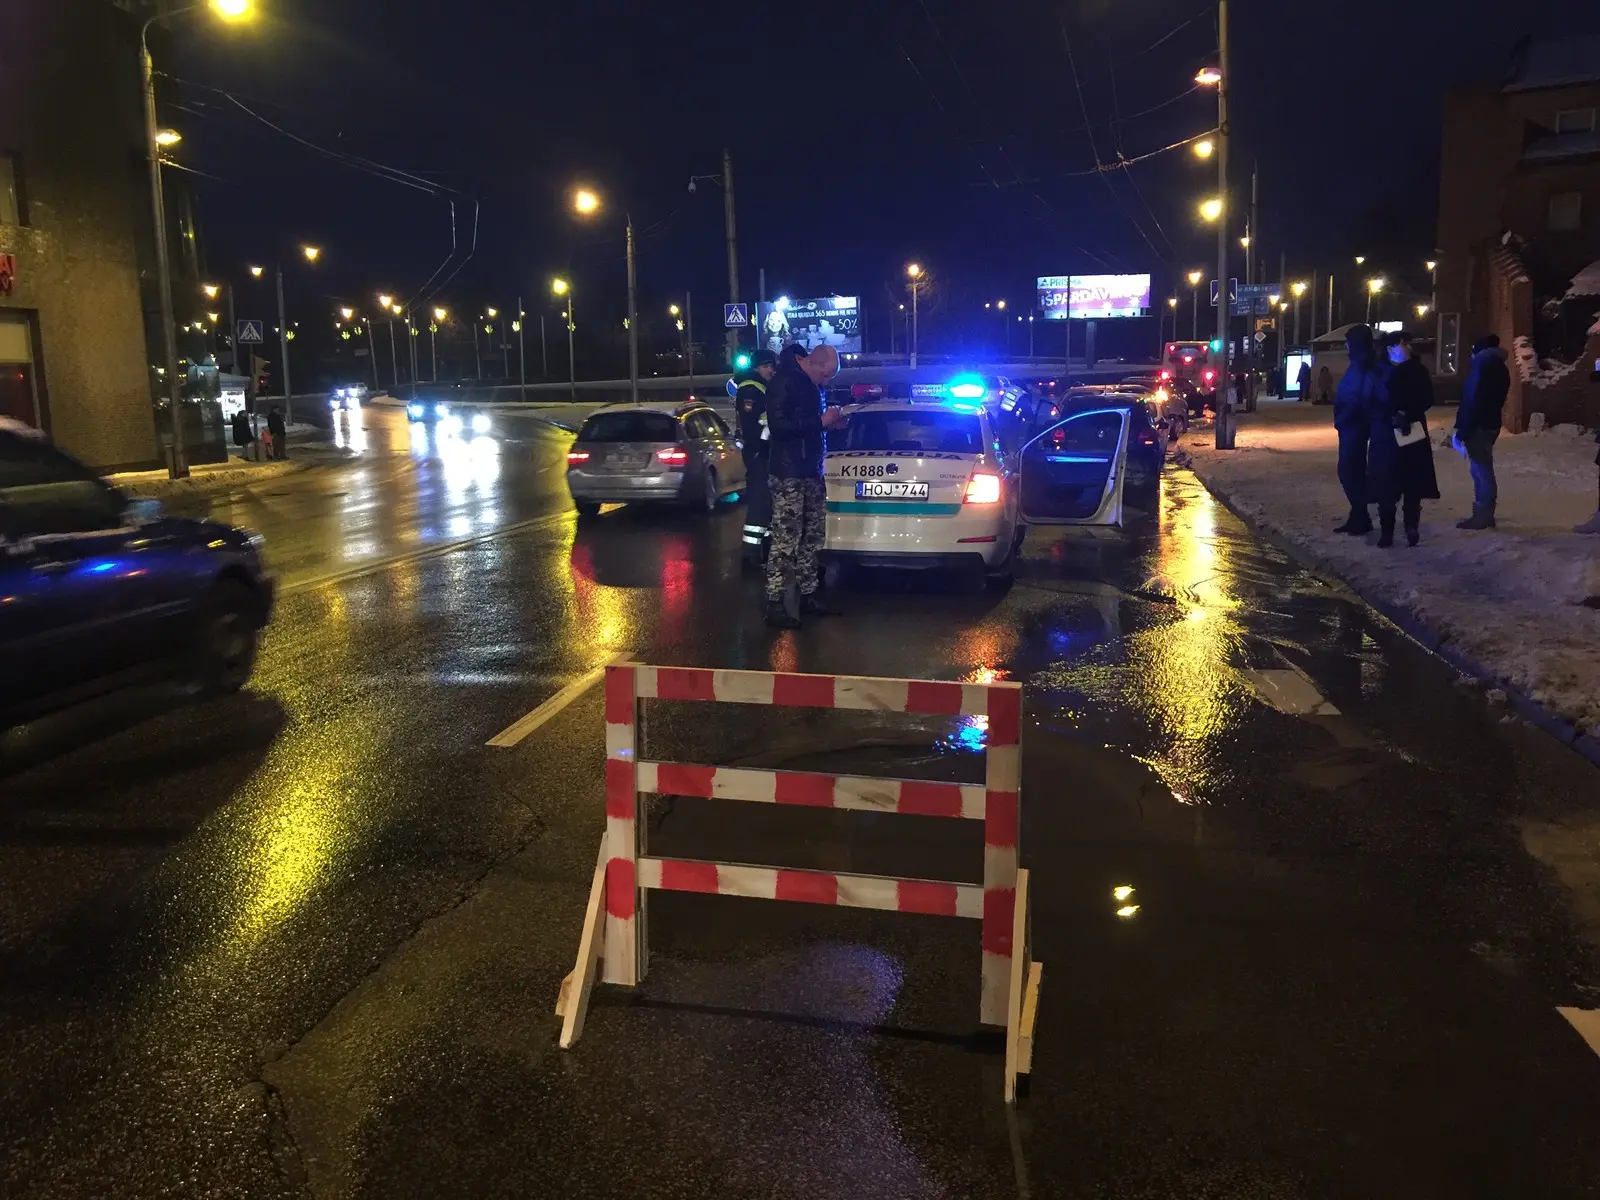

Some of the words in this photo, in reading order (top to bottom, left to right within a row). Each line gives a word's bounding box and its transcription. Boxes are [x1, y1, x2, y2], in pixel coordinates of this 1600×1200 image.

[841, 465, 884, 477] K1888
[864, 485, 893, 496] HOJ
[901, 485, 926, 496] 744
